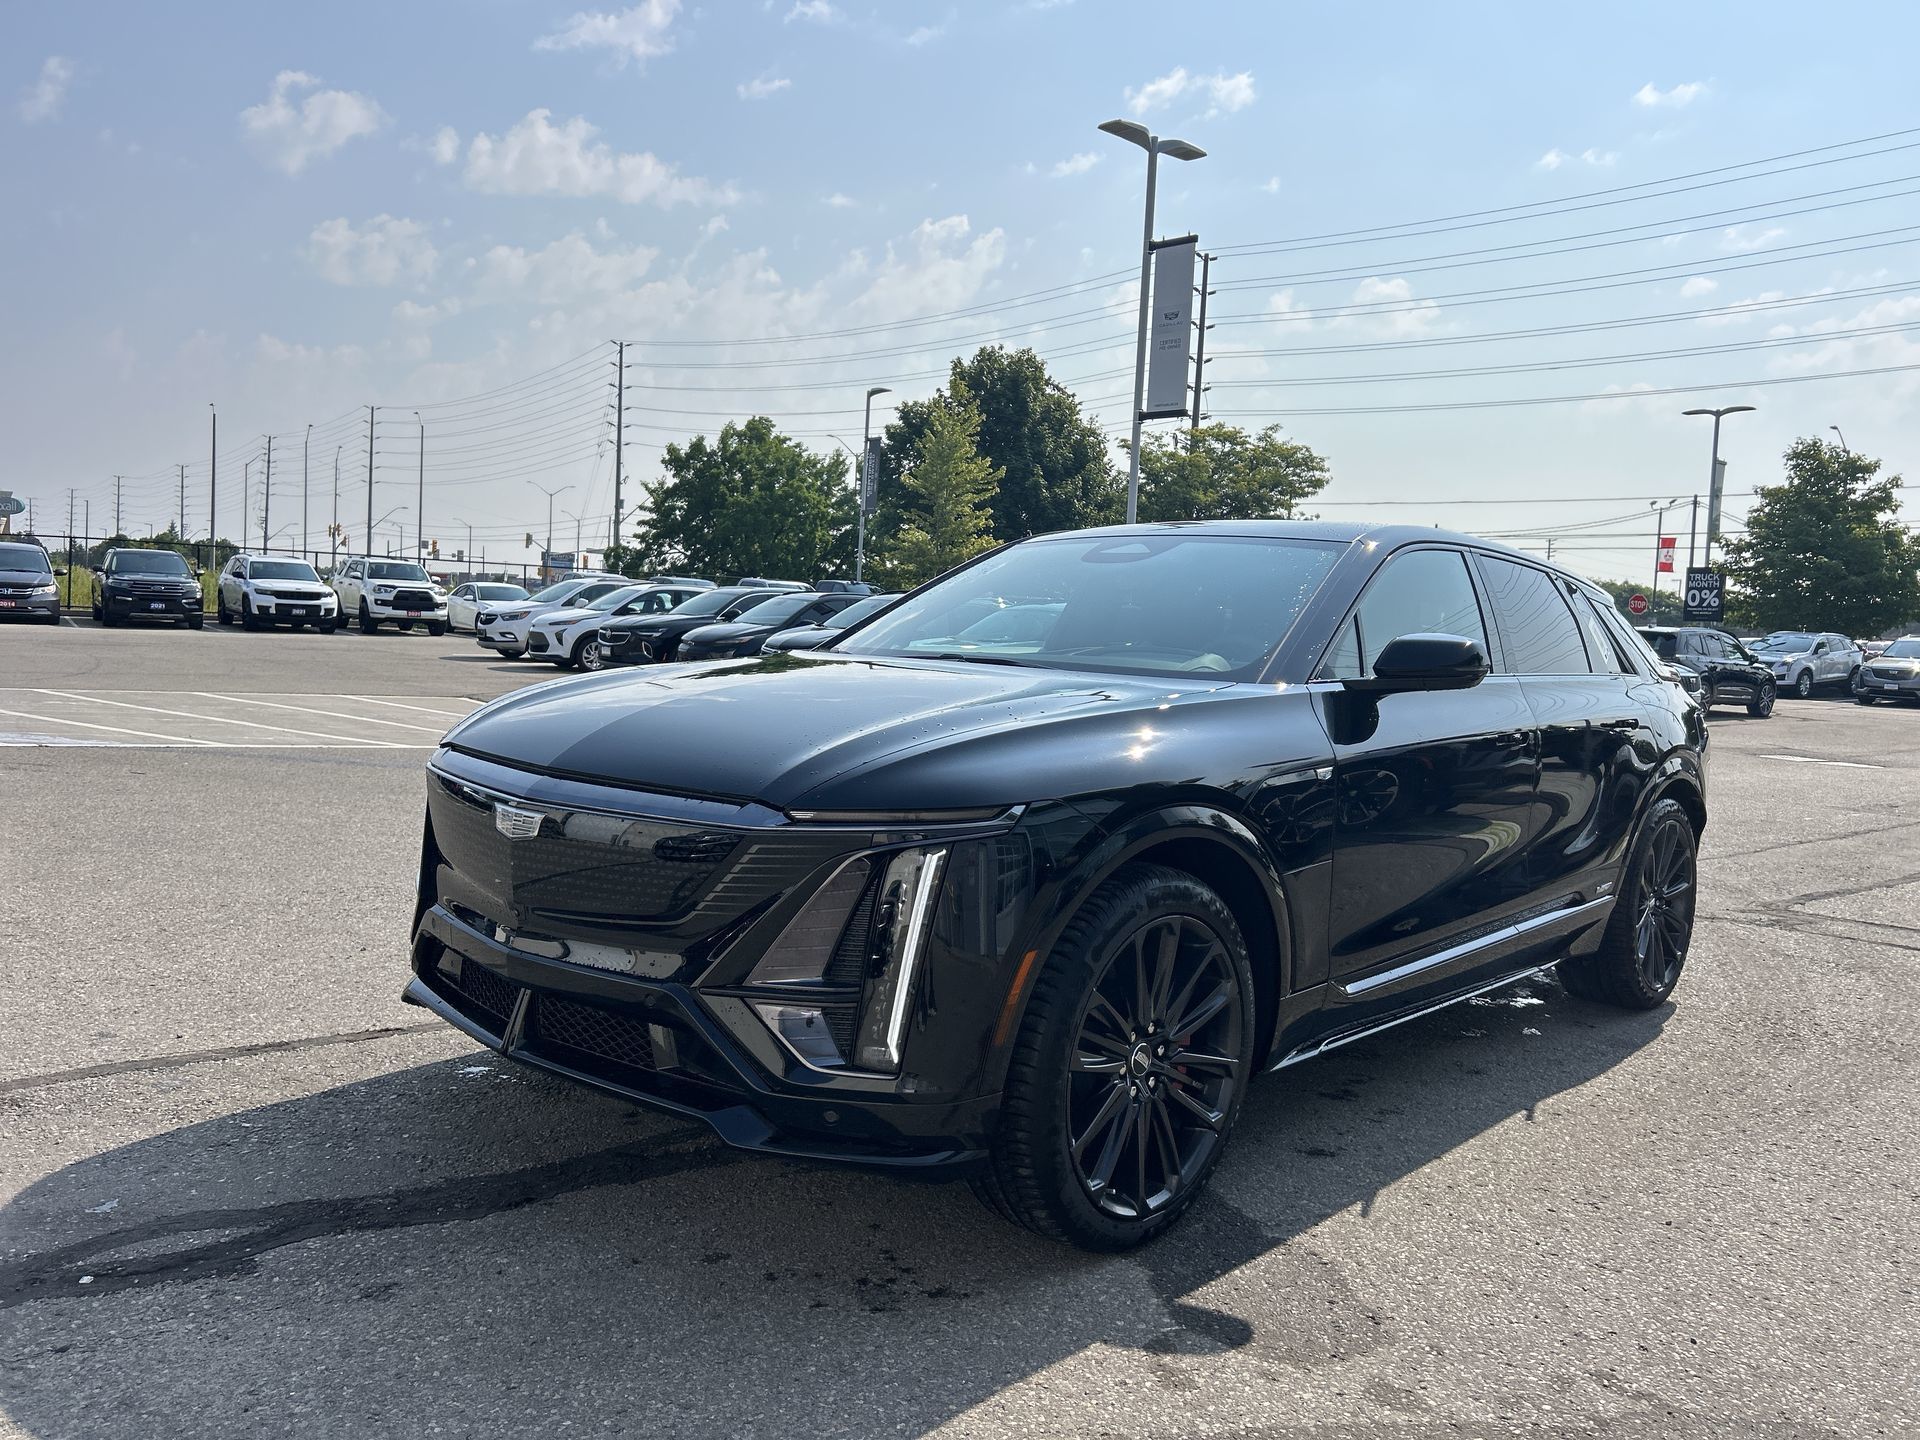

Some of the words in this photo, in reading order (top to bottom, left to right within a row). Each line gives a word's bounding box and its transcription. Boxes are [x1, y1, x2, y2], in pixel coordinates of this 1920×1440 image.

[1689, 573, 1720, 581] TRUCK
[1687, 589, 1720, 607] 0%
[1630, 600, 1646, 609] STOP
